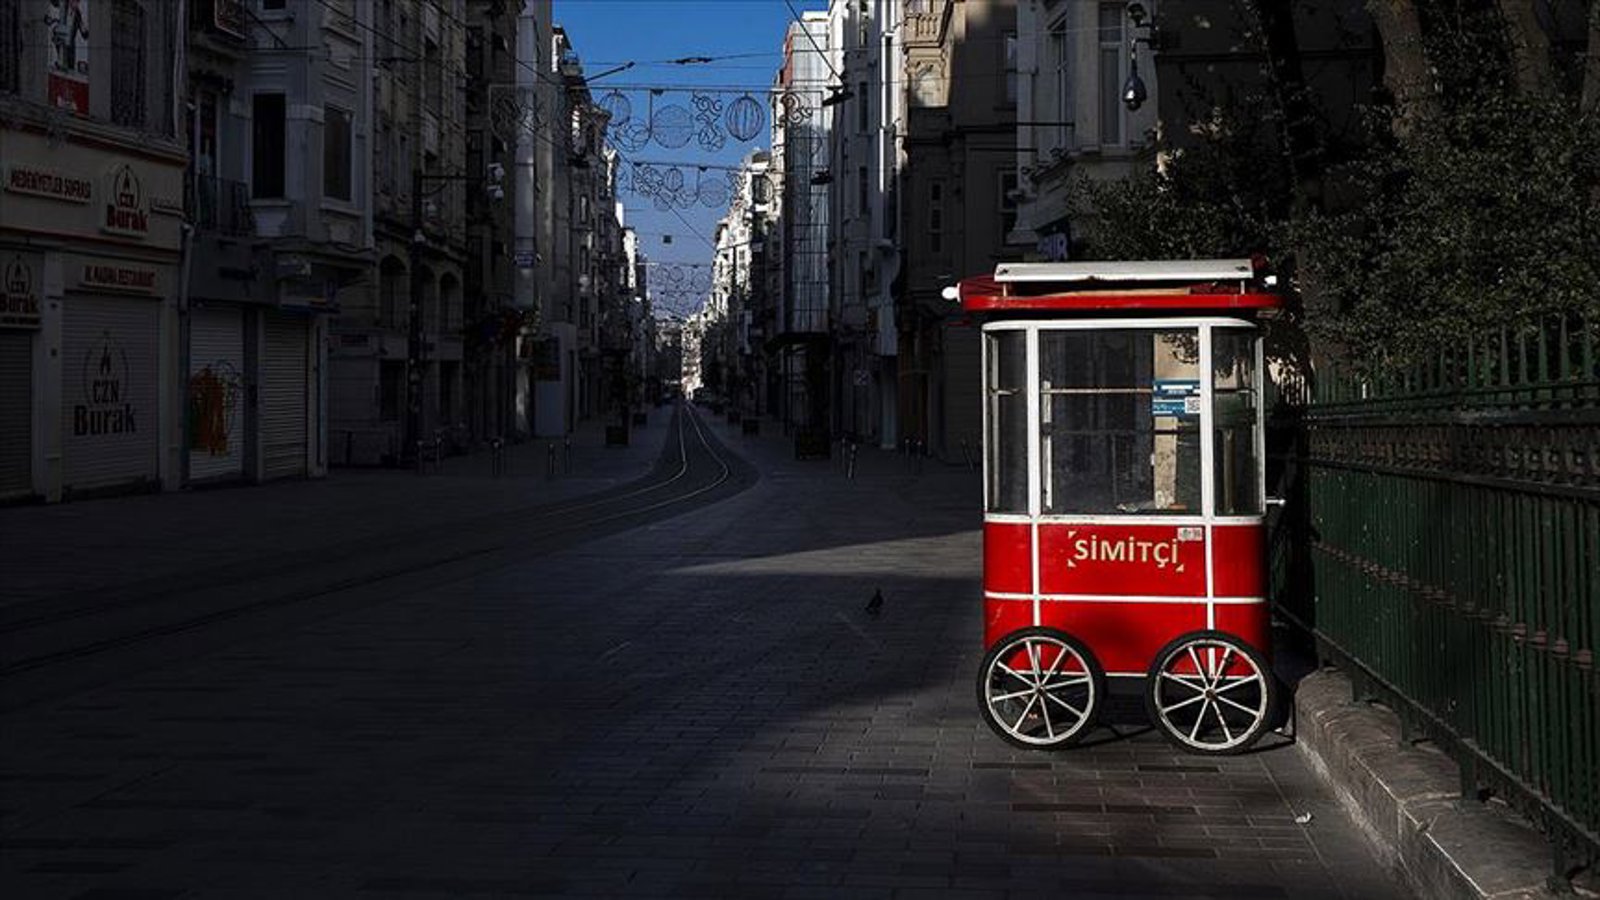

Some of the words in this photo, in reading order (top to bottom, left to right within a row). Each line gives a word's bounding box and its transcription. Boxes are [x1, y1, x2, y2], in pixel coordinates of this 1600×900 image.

[106, 205, 149, 232] Burak
[0, 293, 39, 313] Burak
[92, 380, 120, 403] CZN
[73, 404, 136, 436] Burak
[1073, 534, 1179, 568] SİMİTÇİ
